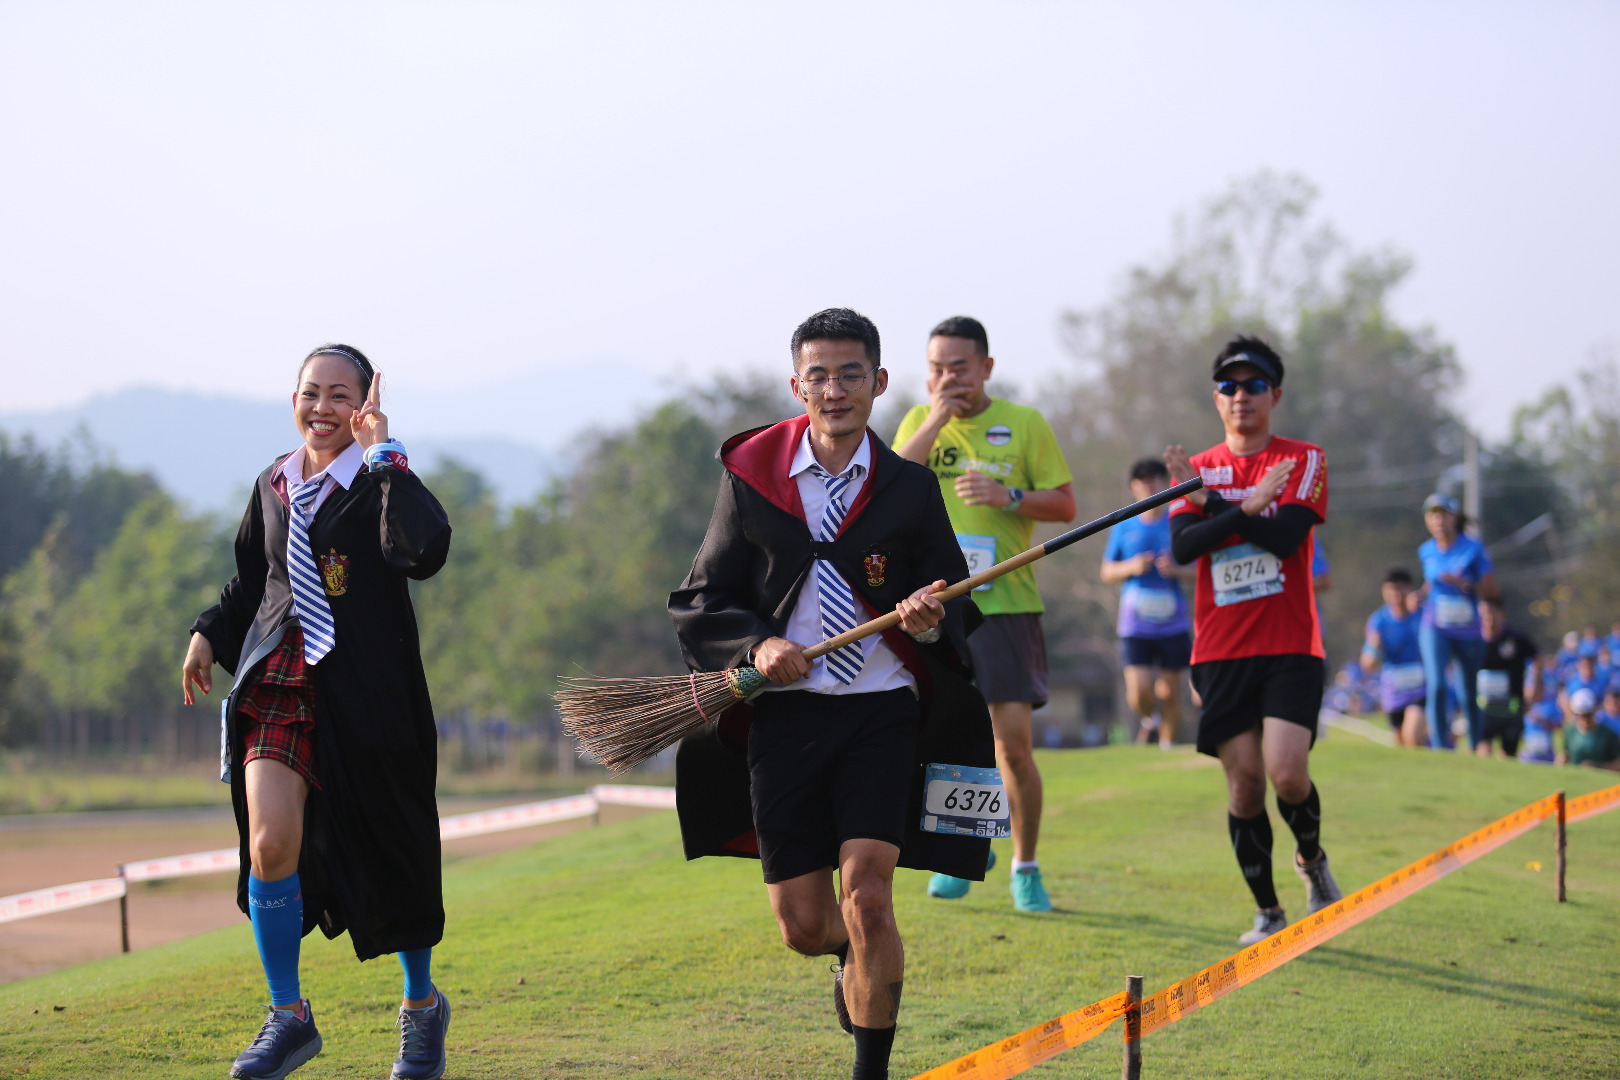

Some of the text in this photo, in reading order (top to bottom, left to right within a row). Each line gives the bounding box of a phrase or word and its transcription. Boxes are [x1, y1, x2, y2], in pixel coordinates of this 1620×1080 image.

[1224, 559, 1266, 585] 6274
[944, 787, 1001, 814] 6376
[266, 896, 287, 907] BAY
